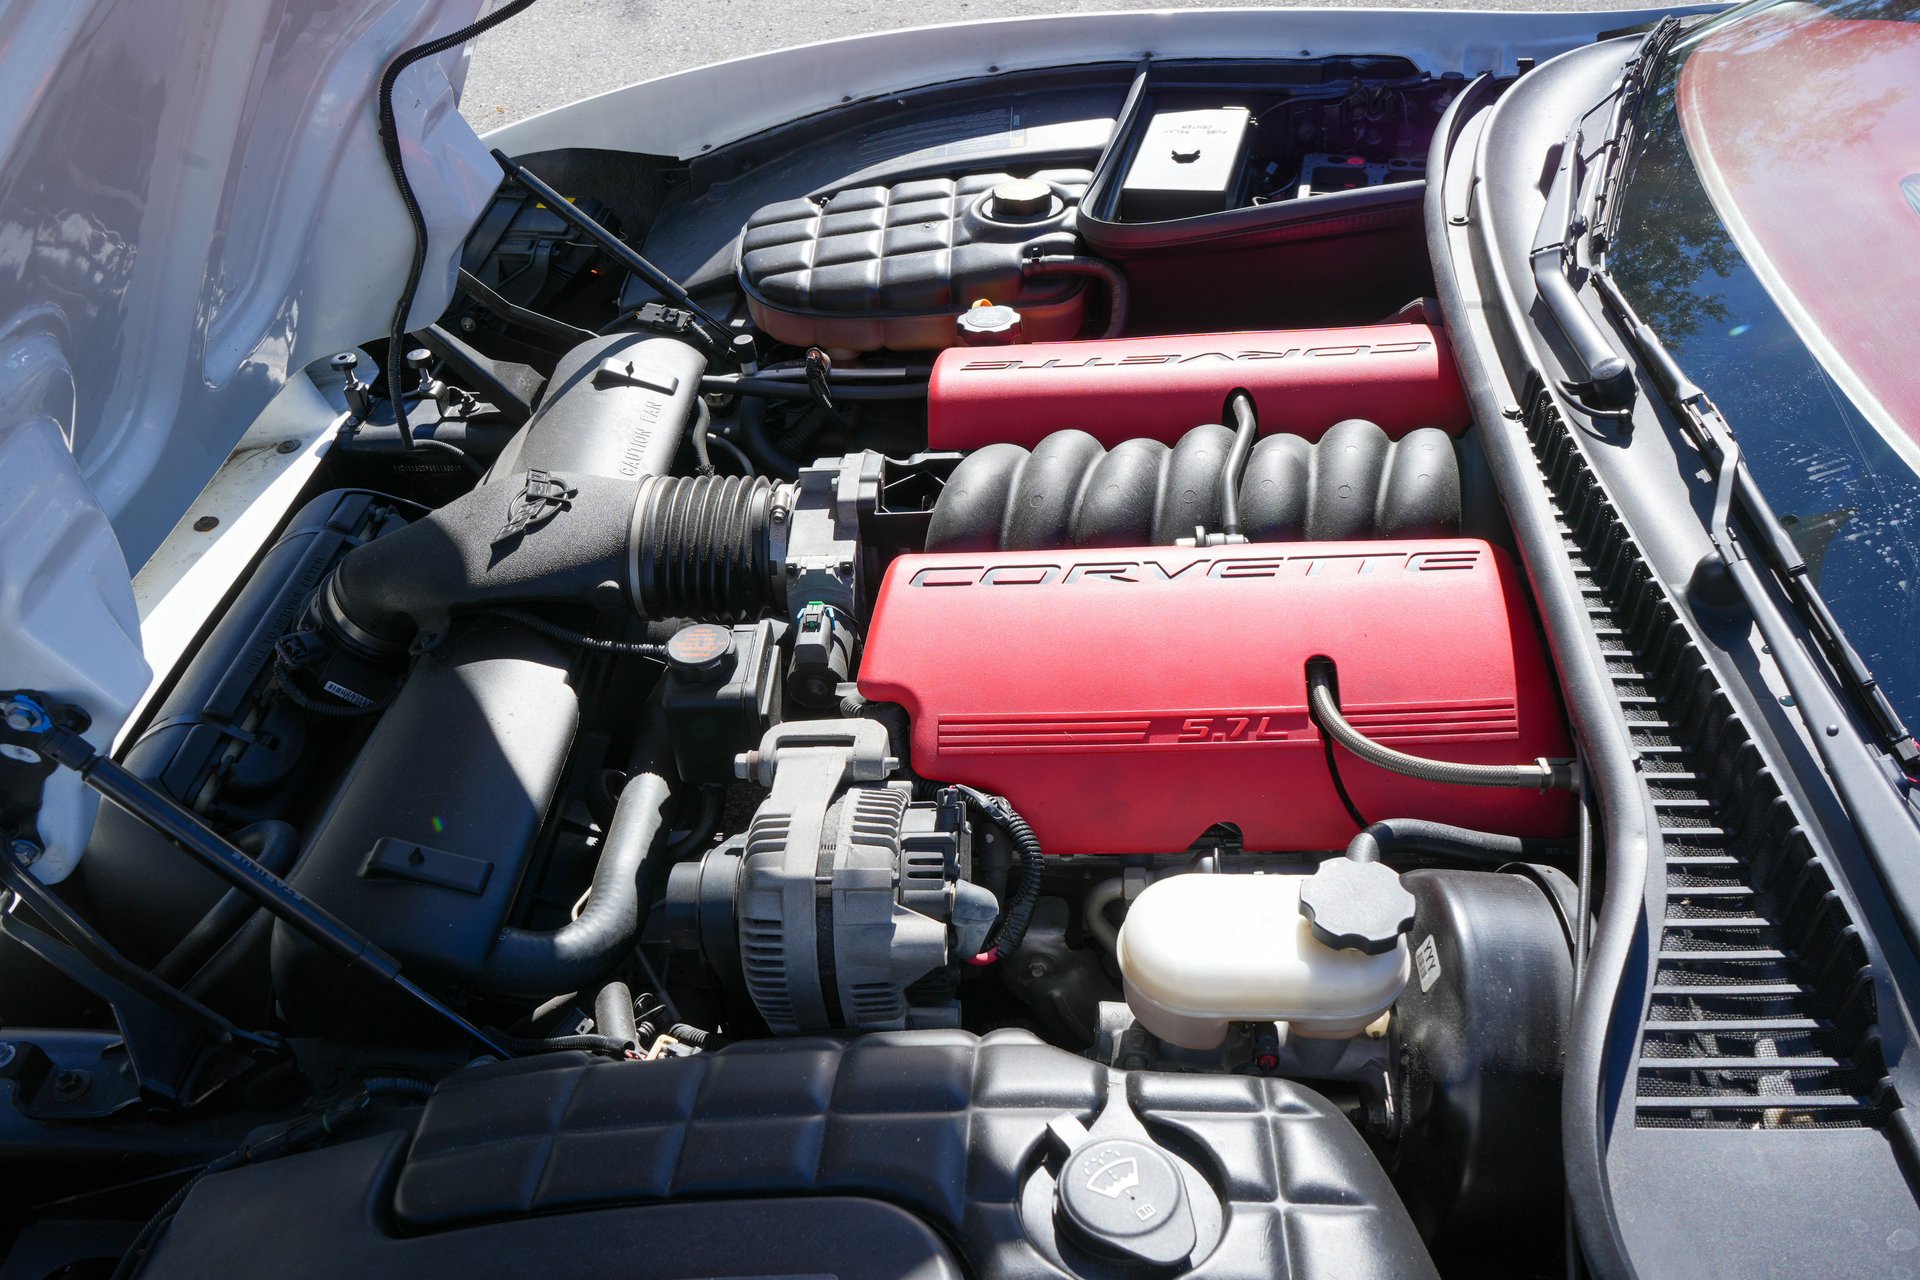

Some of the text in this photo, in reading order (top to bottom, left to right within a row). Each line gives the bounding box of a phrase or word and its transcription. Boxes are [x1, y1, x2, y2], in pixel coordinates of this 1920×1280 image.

[960, 341, 1432, 371] CORVETTE
[619, 400, 663, 476] CAUTION FAN
[909, 550, 1481, 588] CORVETTE
[1178, 716, 1289, 743] 5.7L
[1423, 940, 1436, 971] YYY
